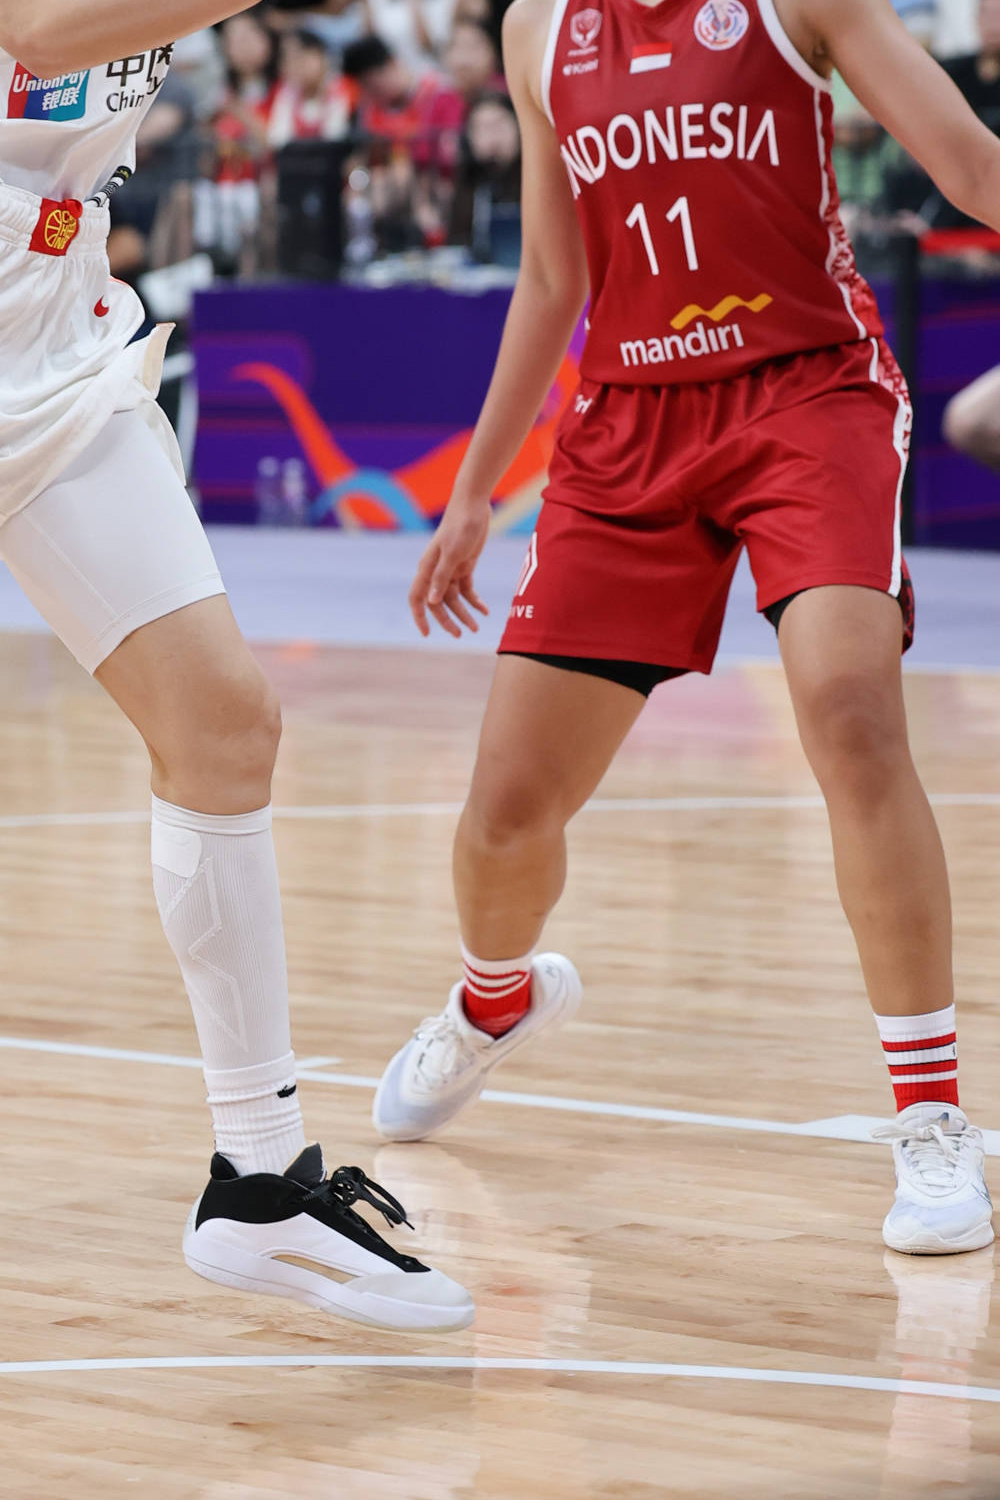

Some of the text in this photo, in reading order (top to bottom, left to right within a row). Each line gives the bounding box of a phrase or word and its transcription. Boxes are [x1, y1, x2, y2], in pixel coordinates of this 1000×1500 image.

[12, 69, 88, 93] UnionPay
[41, 87, 80, 111] 银联
[625, 195, 700, 277] 11
